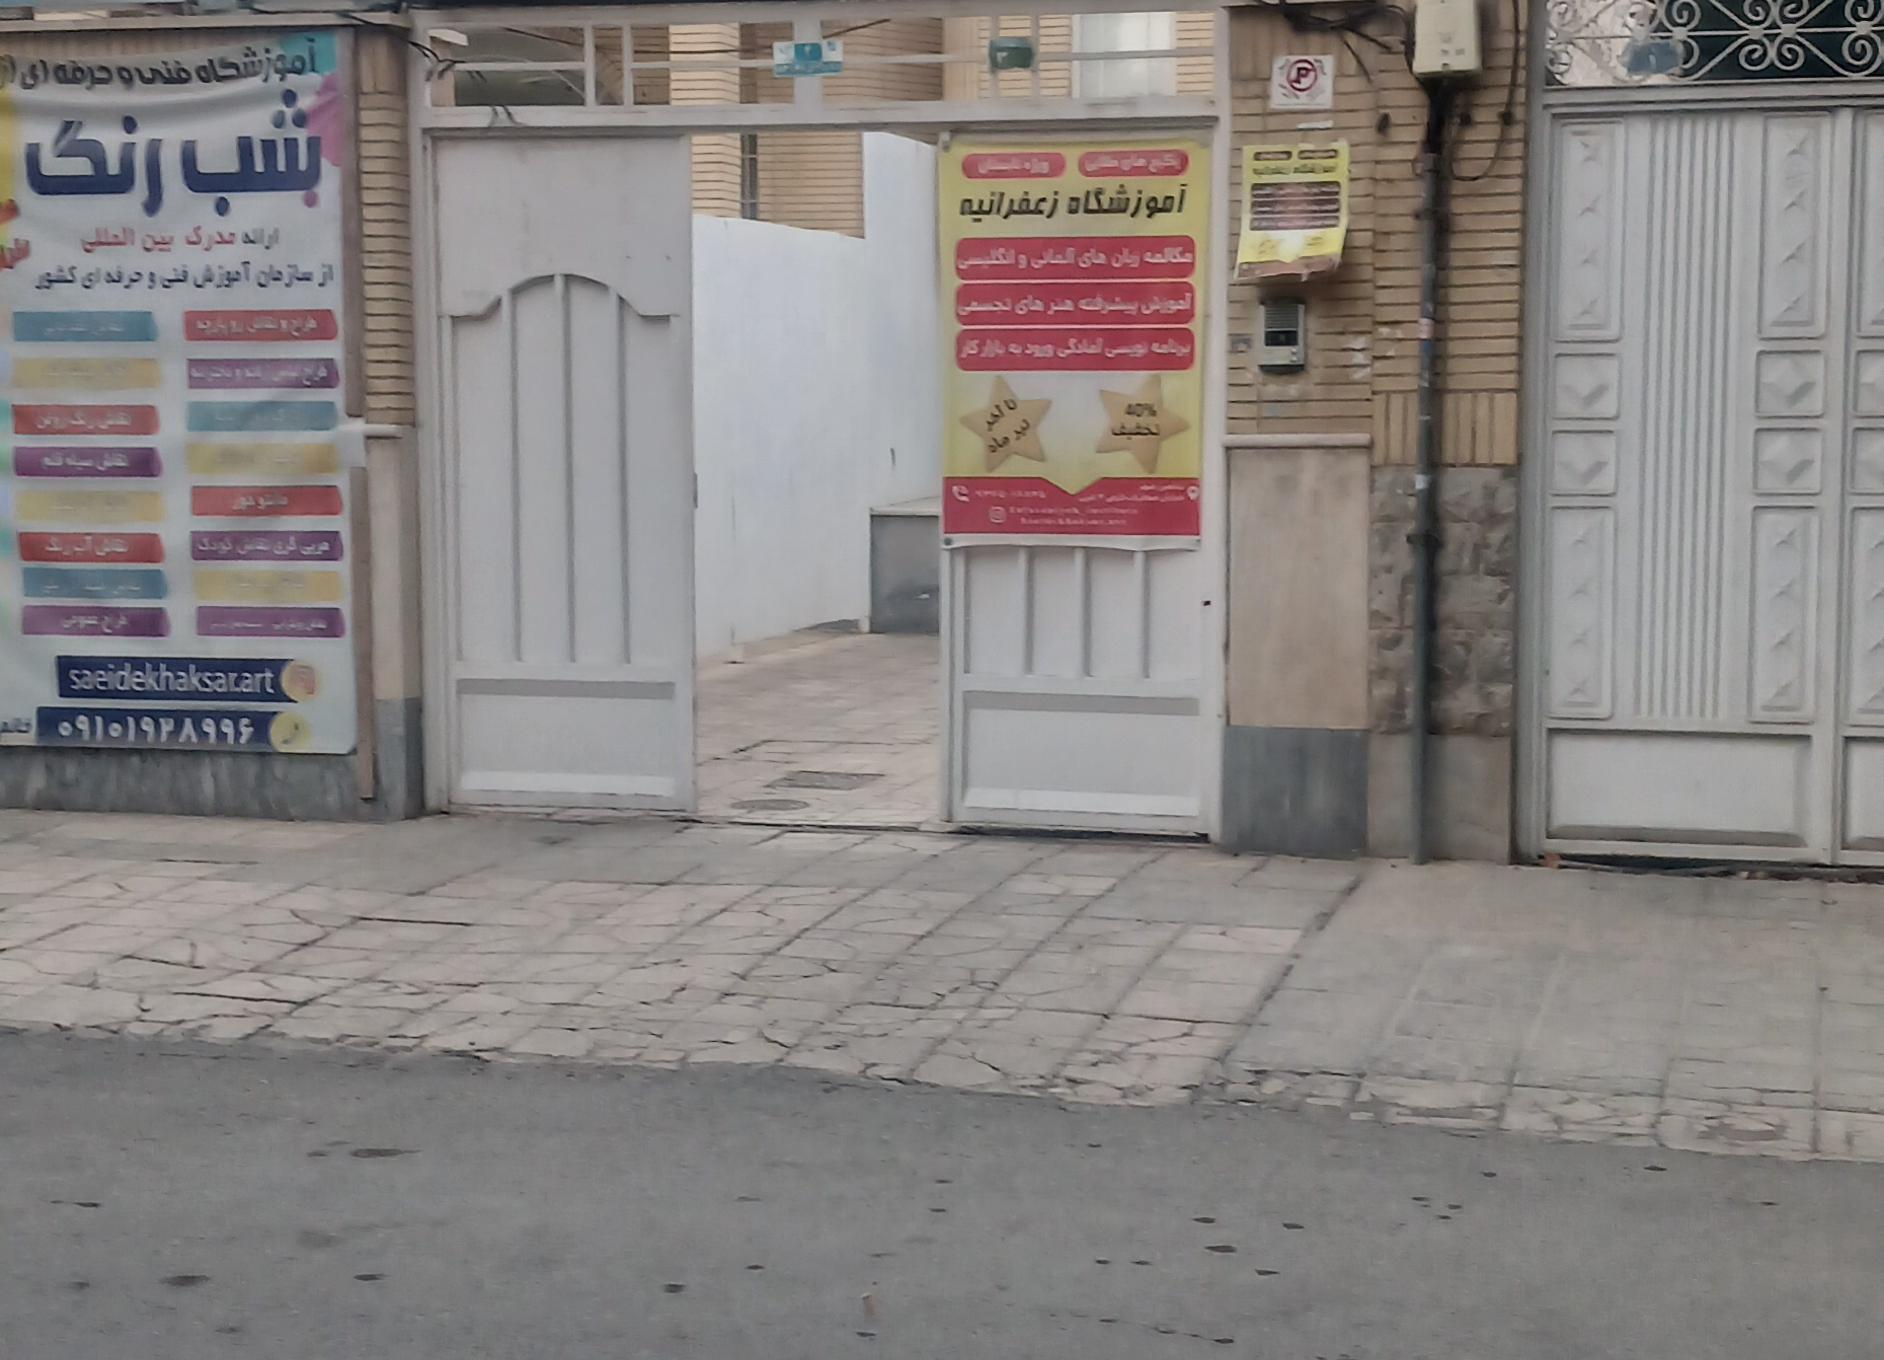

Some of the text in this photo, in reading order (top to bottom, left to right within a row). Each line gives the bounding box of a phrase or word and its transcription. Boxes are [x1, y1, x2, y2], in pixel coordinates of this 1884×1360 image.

[134, 59, 195, 85] فنی
[195, 37, 320, 84] آموزشگاه
[20, 58, 49, 90] ای
[53, 59, 114, 91] حرفه
[119, 64, 135, 89] و
[25, 88, 324, 218] شب رنگ
[958, 183, 1189, 224] آموزشگاه زعفرانیه
[1017, 251, 1028, 269] و
[1077, 247, 1108, 269] های
[1143, 246, 1194, 265] مکالمه
[147, 269, 157, 289] و
[161, 264, 190, 289] فنی
[192, 260, 252, 289] آموزش
[256, 263, 314, 289] سازمان
[317, 262, 335, 288] از
[1125, 402, 1158, 418] 40%
[1111, 421, 1161, 441] تخفیف
[68, 661, 275, 695] saeidekhaksar.art
